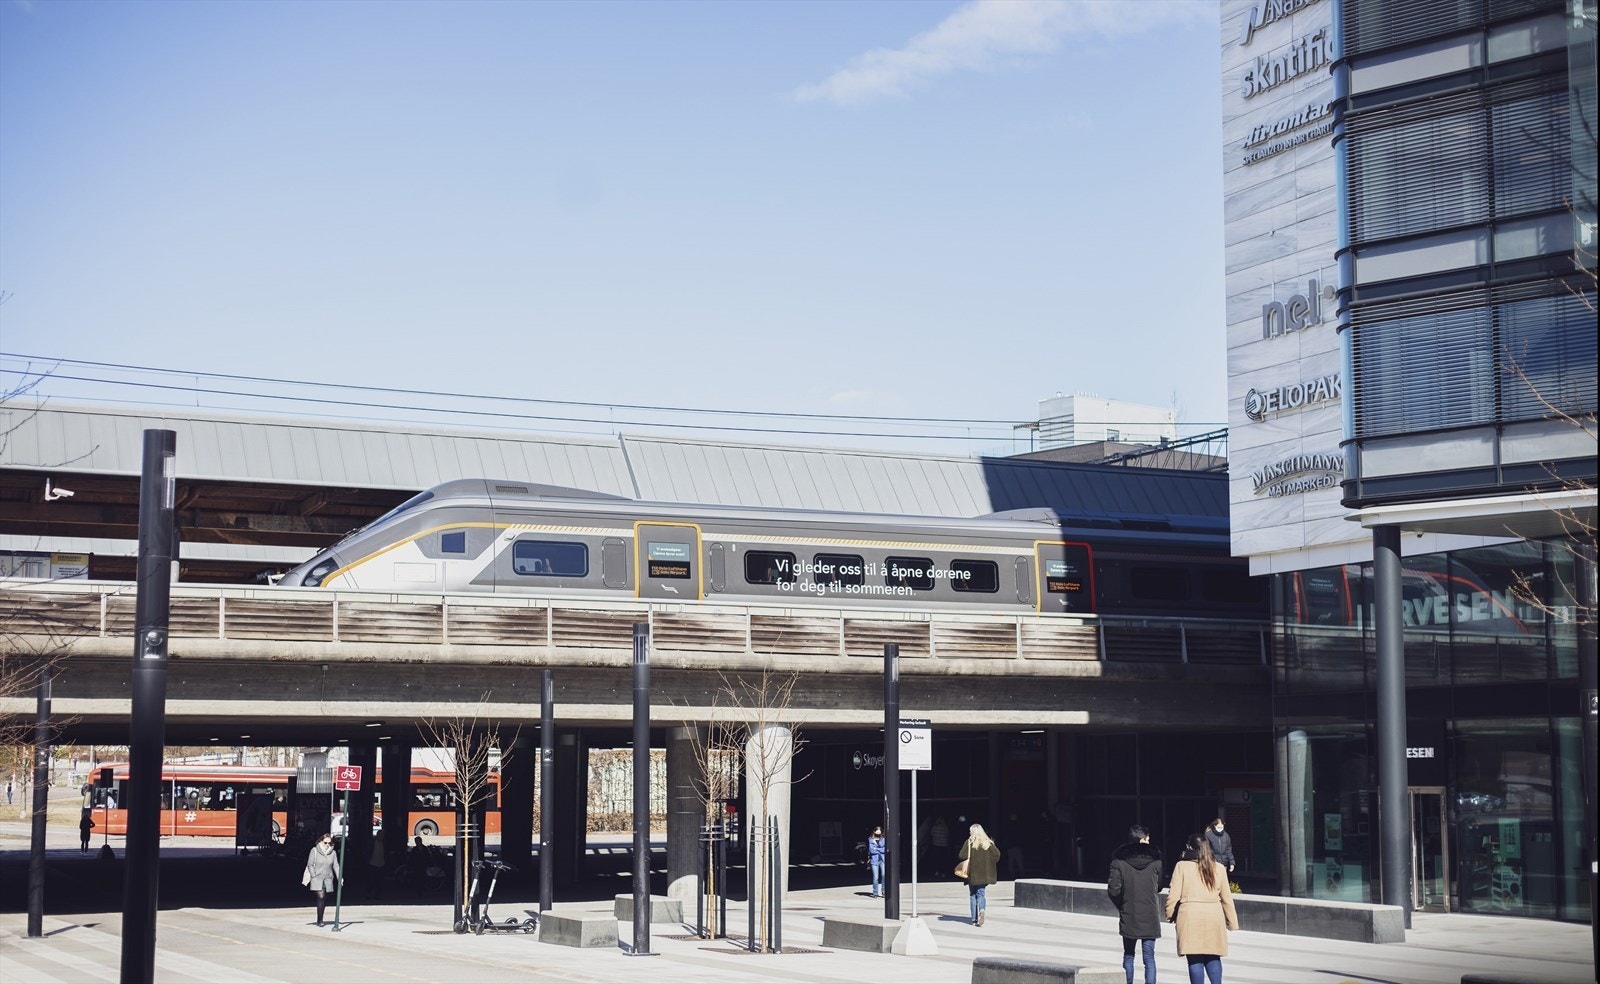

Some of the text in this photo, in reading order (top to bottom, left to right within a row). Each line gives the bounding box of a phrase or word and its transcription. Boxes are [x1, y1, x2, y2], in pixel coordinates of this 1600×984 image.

[1242, 101, 1333, 148] Aircontac
[1294, 133, 1307, 146] AIR
[1264, 374, 1342, 412] ELOPAK
[1268, 474, 1332, 497] MATMARKED
[775, 559, 971, 581] Vi gleder oss til å åpne dørene
[776, 577, 917, 597] for deg til sommeren.
